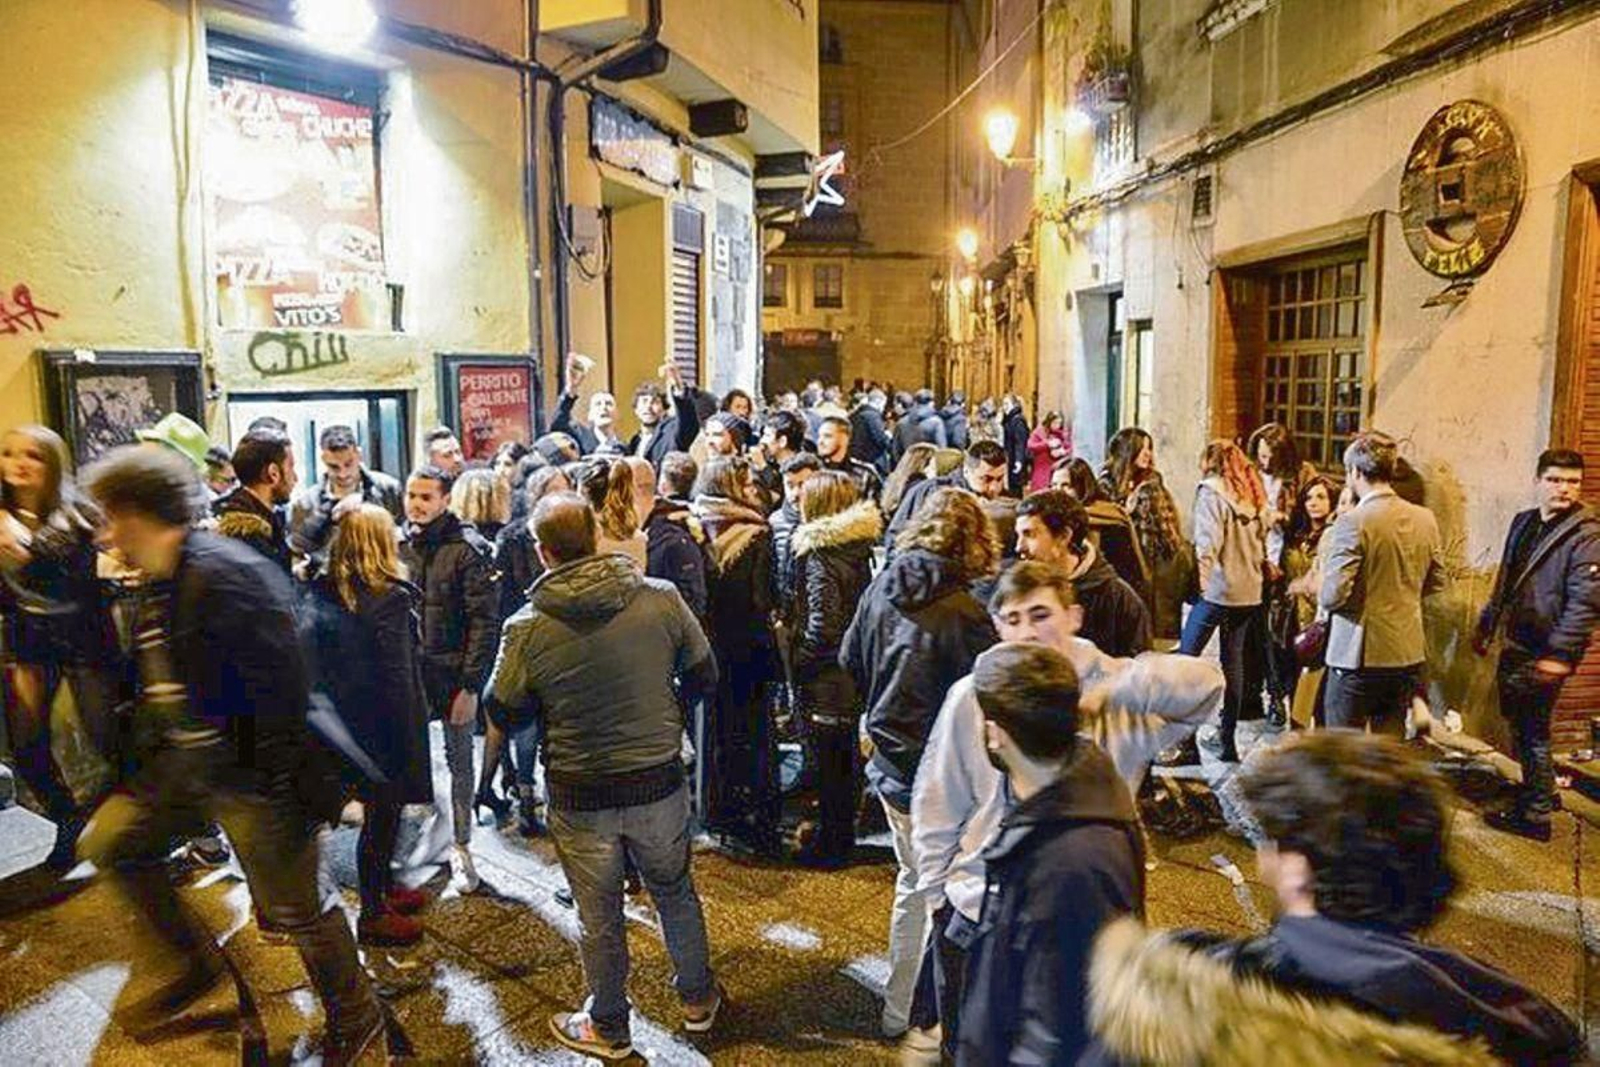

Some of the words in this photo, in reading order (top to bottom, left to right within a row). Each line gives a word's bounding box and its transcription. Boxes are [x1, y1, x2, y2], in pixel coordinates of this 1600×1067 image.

[273, 306, 342, 327] VITO'S
[460, 373, 521, 391] PERRITO
[467, 388, 528, 407] CALIENTE
